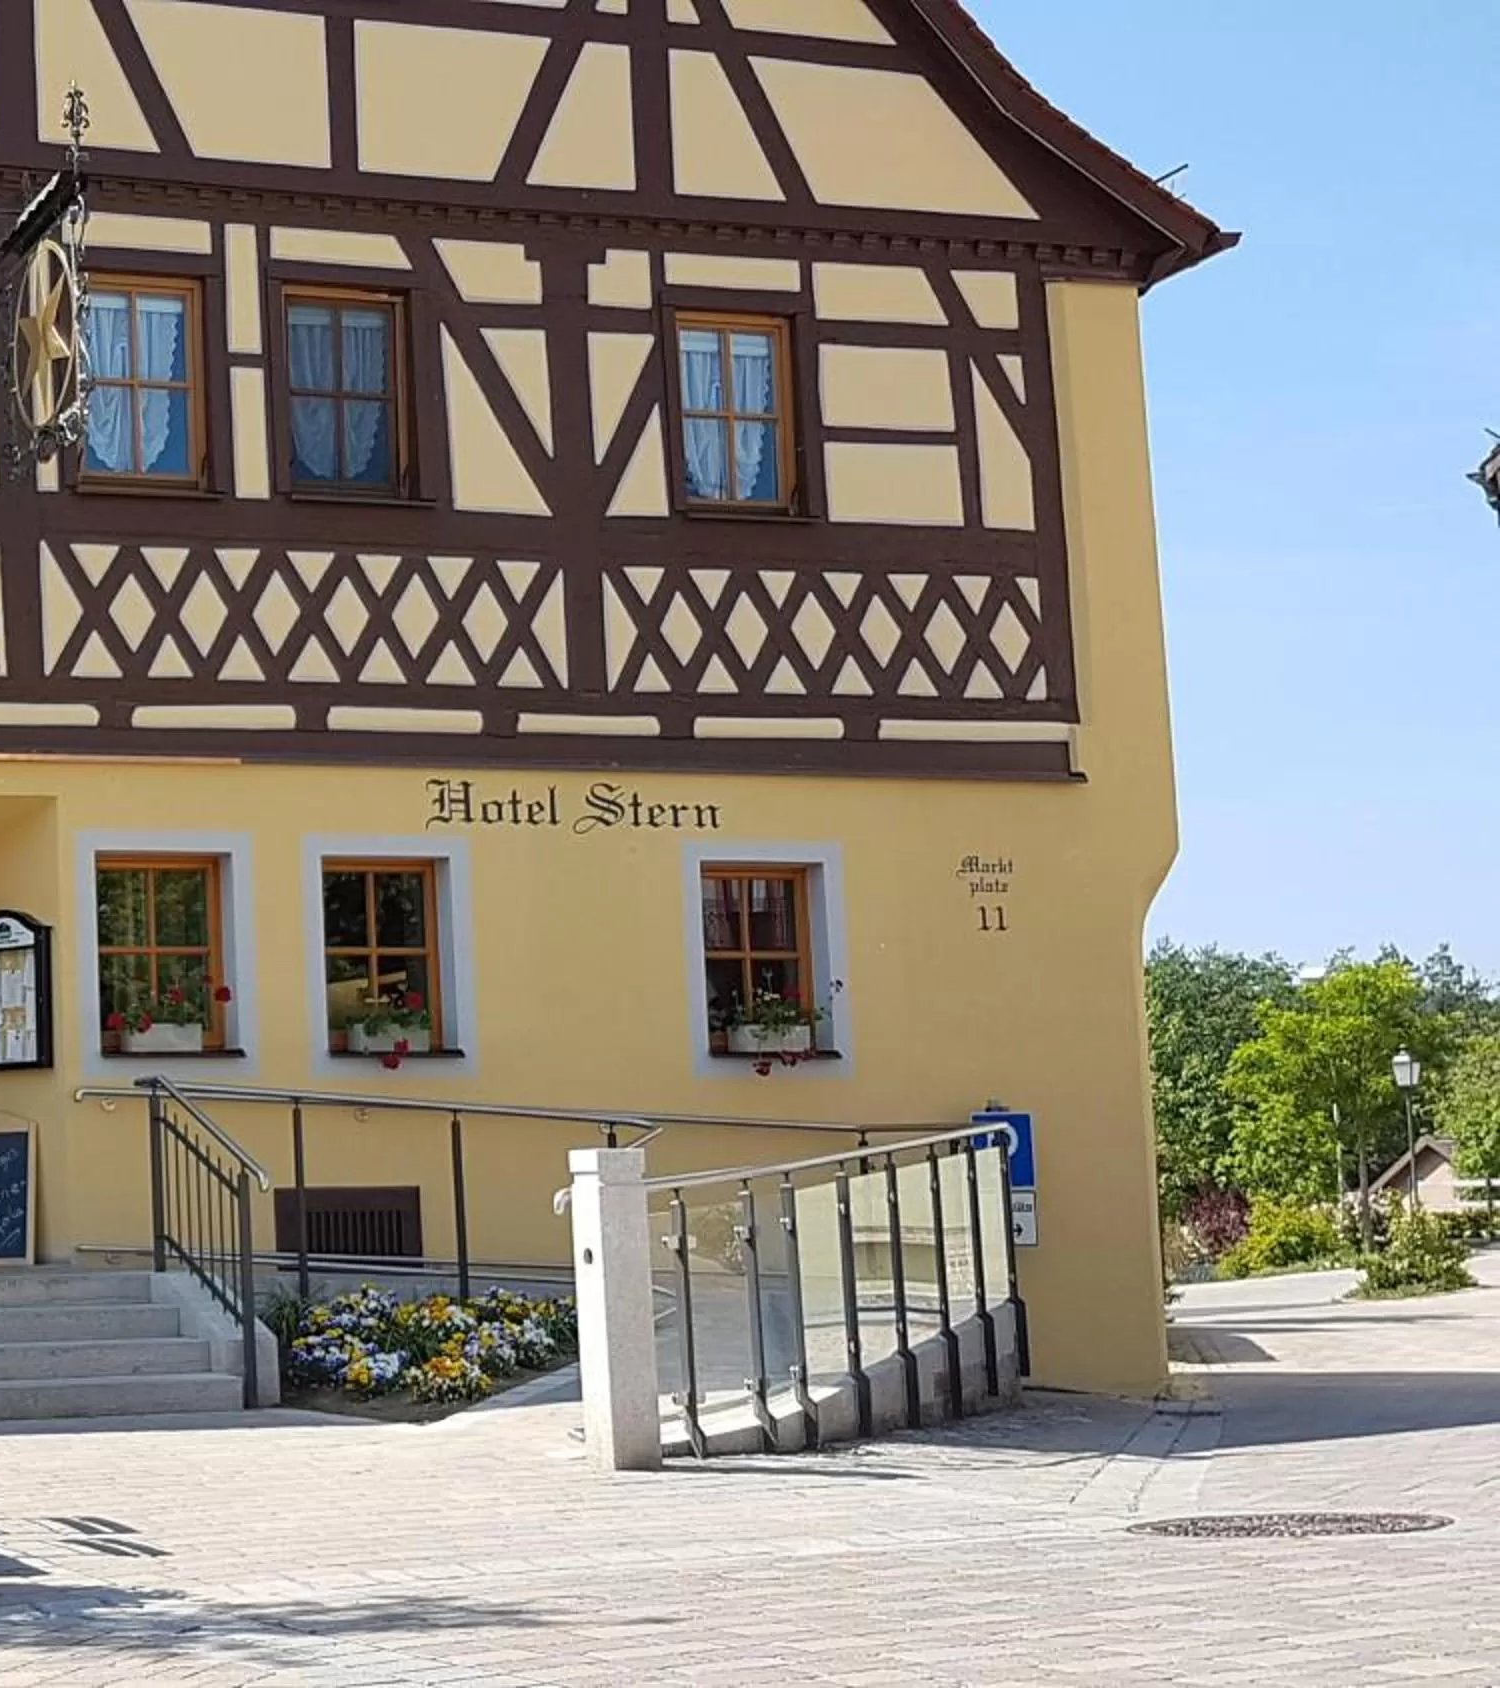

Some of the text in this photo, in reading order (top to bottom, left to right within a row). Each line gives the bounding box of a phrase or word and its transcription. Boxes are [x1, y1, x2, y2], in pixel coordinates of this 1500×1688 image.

[425, 778, 722, 835] Hotel Stern
[956, 855, 1013, 879] Markt
[969, 876, 1009, 898] platz
[977, 905, 1010, 931] 11
